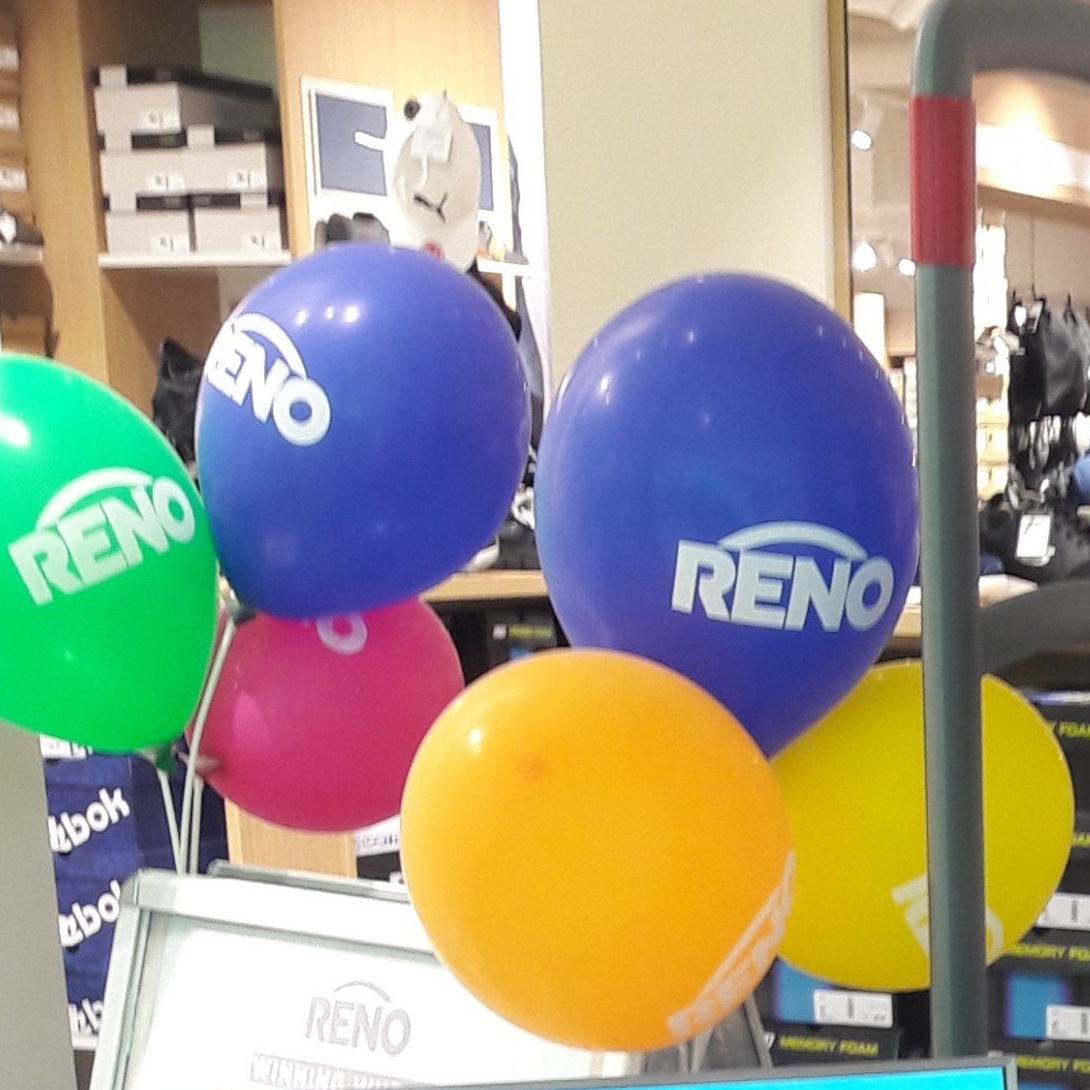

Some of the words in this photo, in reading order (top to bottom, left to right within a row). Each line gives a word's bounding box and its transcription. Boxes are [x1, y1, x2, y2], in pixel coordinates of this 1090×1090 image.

[8, 468, 196, 606] RENO
[671, 524, 894, 632] RENO
[1007, 943, 1066, 960] EMORY
[305, 984, 411, 1056] RENO
[780, 1036, 837, 1054] MEMORY
[839, 1040, 879, 1057] FOAM
[1016, 1055, 1069, 1071] EMORY
